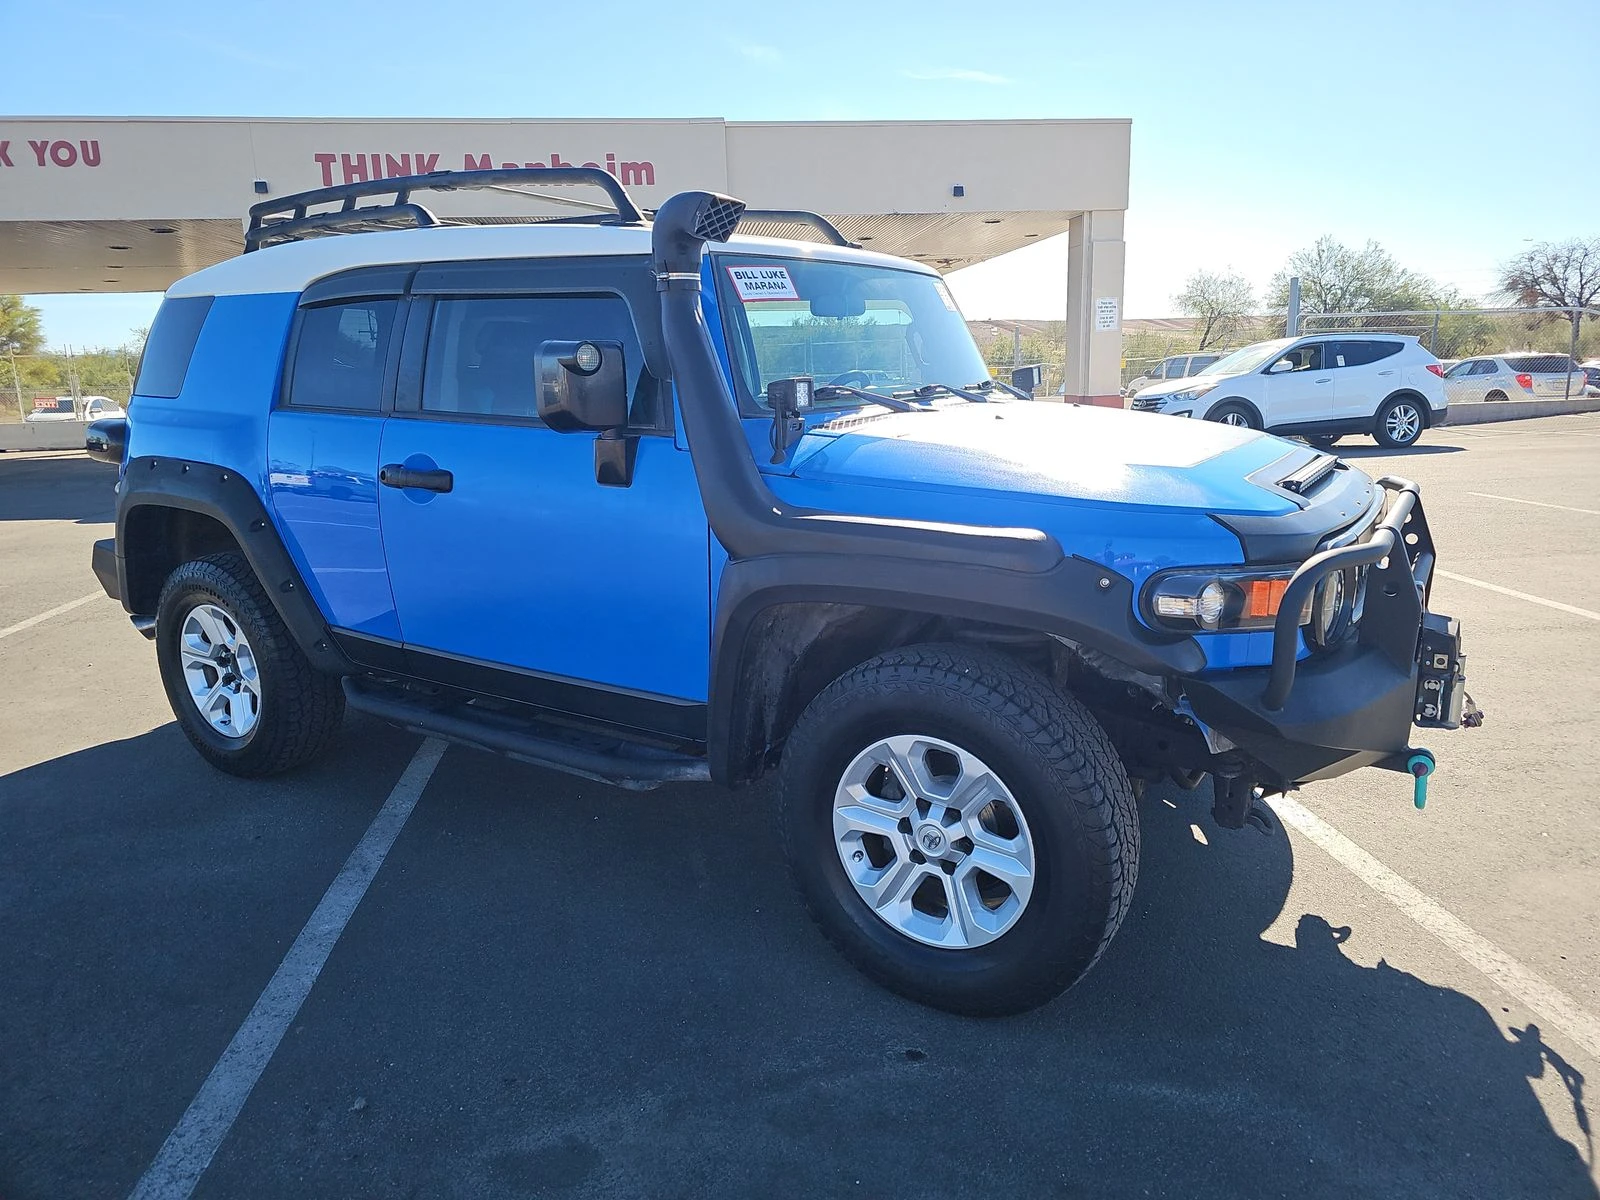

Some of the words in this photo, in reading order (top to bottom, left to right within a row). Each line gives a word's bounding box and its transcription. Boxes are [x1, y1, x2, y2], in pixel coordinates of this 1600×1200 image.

[27, 140, 101, 168] YOU
[315, 153, 440, 187] THINK
[464, 153, 655, 186] Mhim
[734, 270, 758, 280] BILL
[760, 271, 787, 279] LUKE
[744, 281, 787, 290] MARANA
